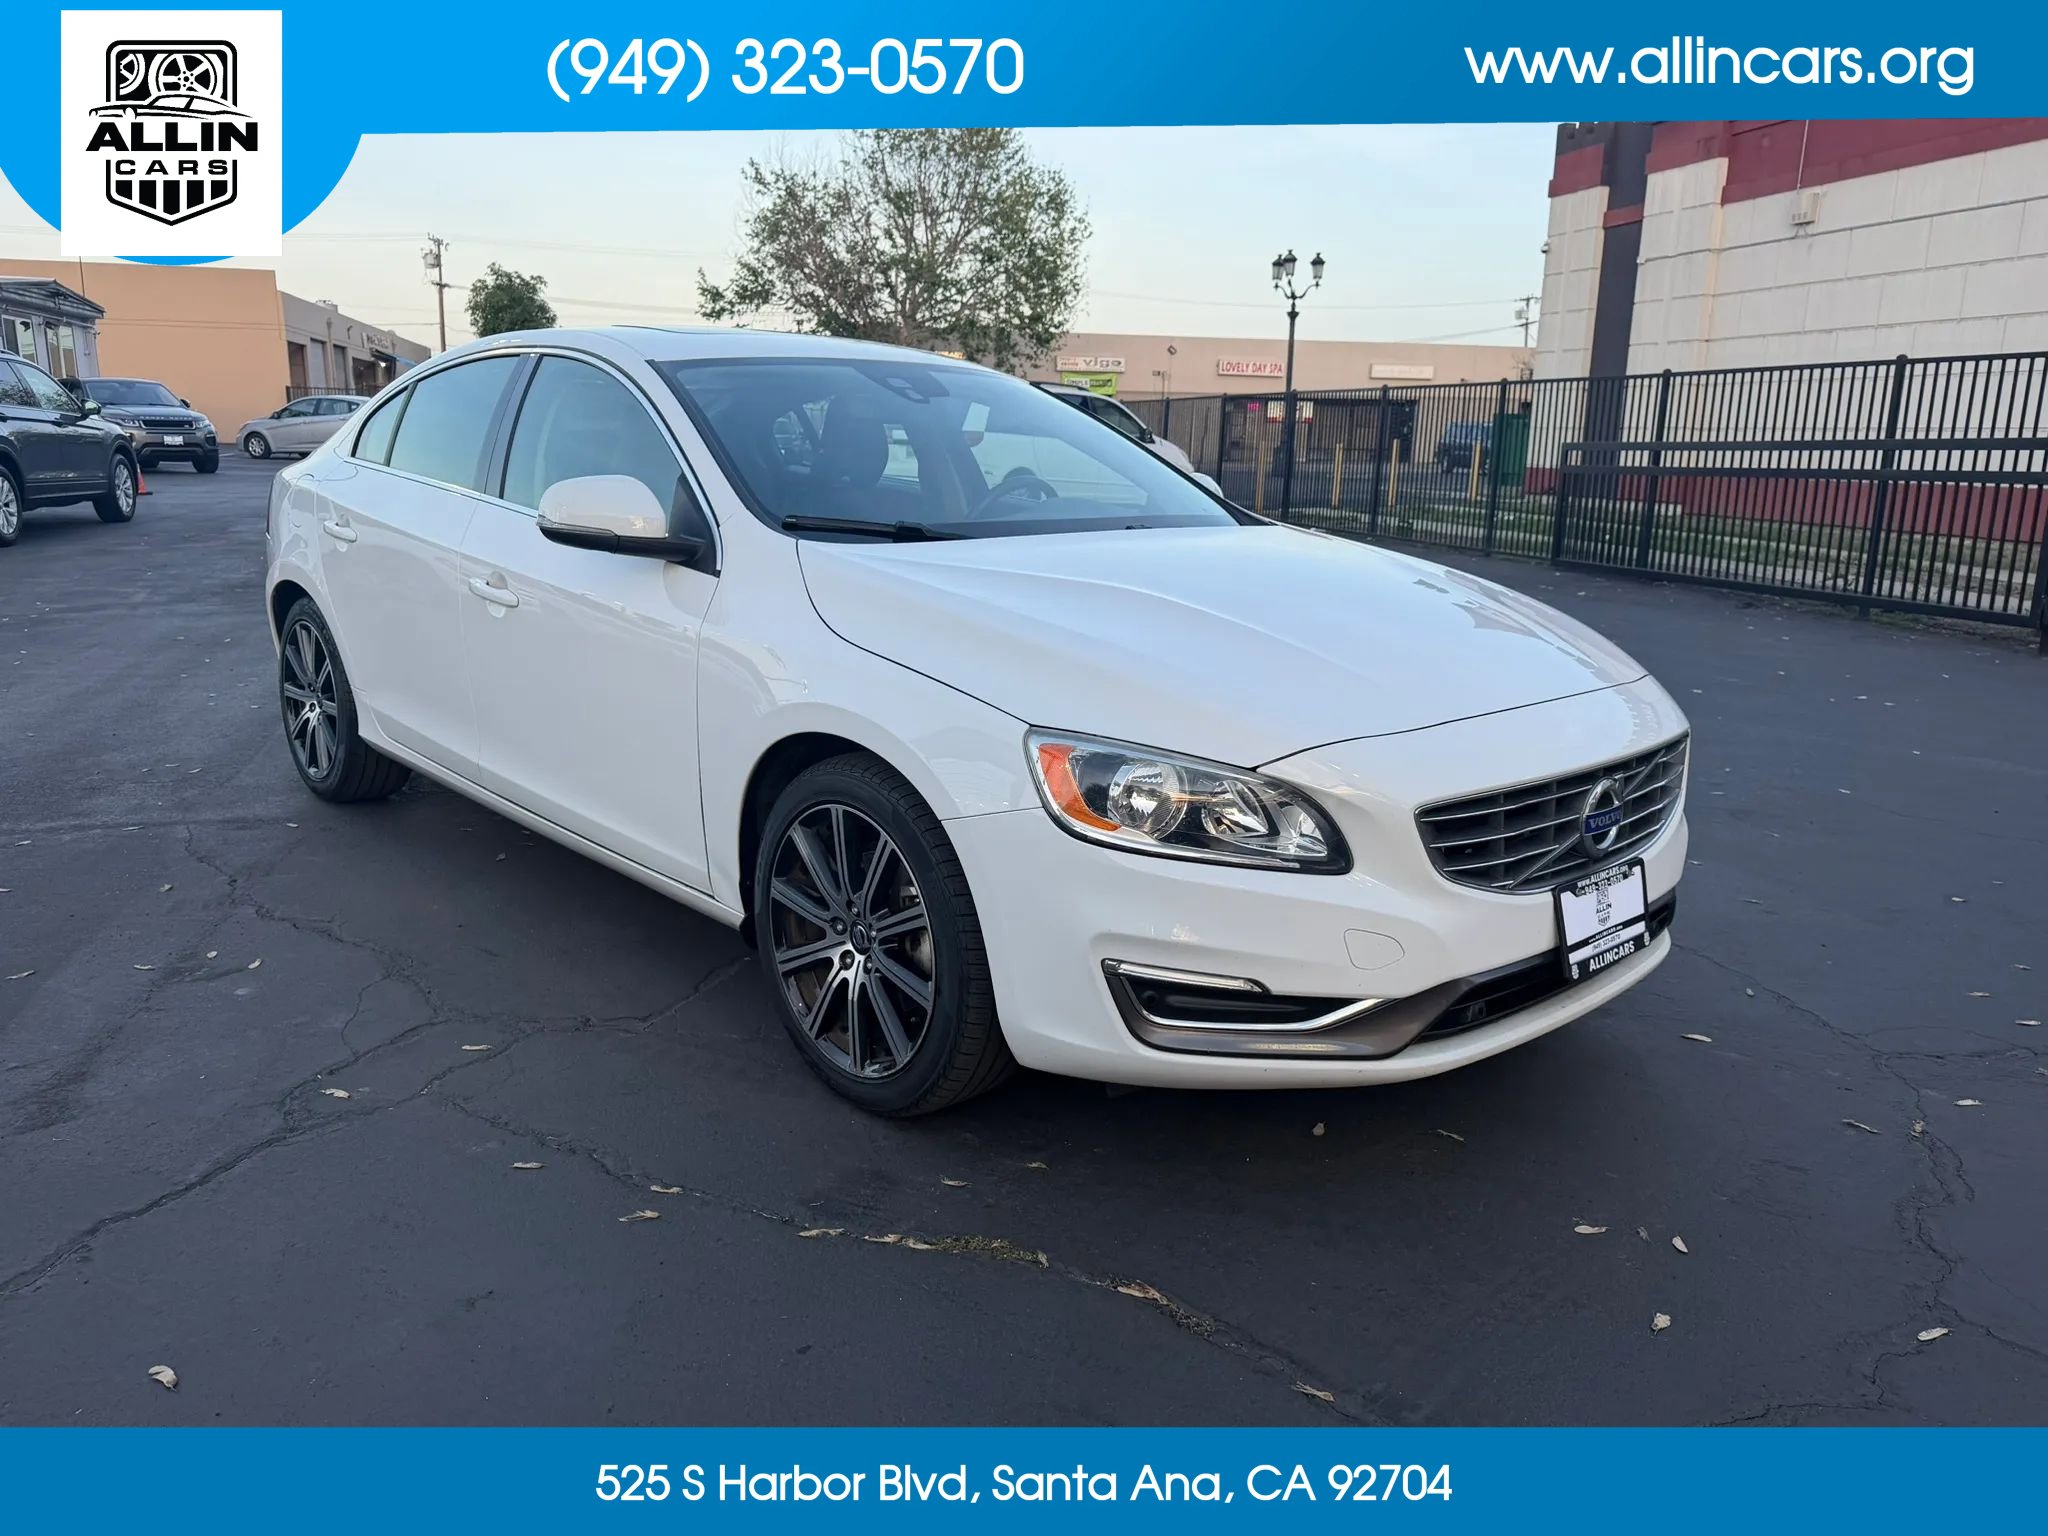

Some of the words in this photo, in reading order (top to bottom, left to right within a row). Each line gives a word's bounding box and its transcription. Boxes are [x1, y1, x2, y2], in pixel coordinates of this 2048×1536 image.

[1221, 361, 1250, 373] LOVELY
[1252, 362, 1267, 373] DAY
[1269, 363, 1282, 374] SPA
[1595, 902, 1612, 914] ALLIN
[1589, 940, 1635, 972] ALLINCARS
